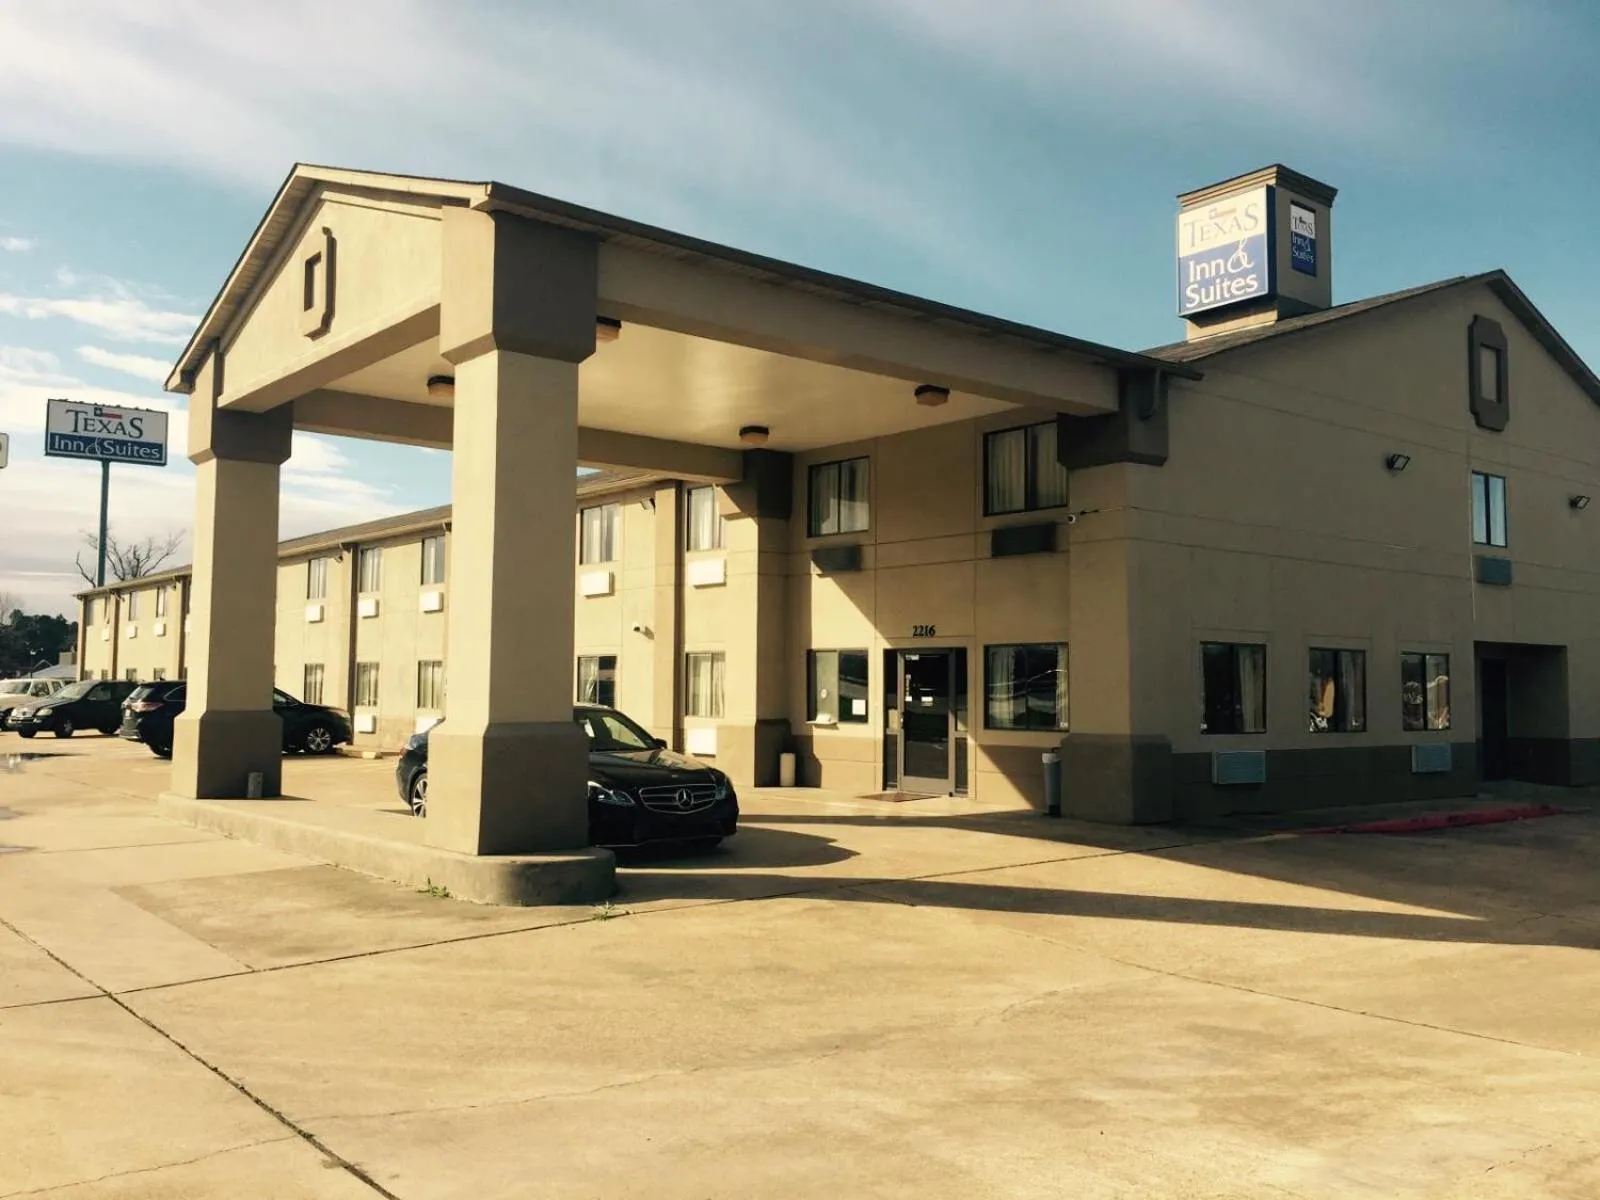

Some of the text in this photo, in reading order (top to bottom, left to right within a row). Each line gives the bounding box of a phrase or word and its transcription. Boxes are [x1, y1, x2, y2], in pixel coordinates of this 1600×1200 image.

[1189, 236, 1255, 283] Inn &
[1293, 244, 1314, 263] Suites
[1185, 273, 1259, 308] Suites
[54, 435, 161, 459] Inn & Suites
[912, 624, 937, 638] 2216
